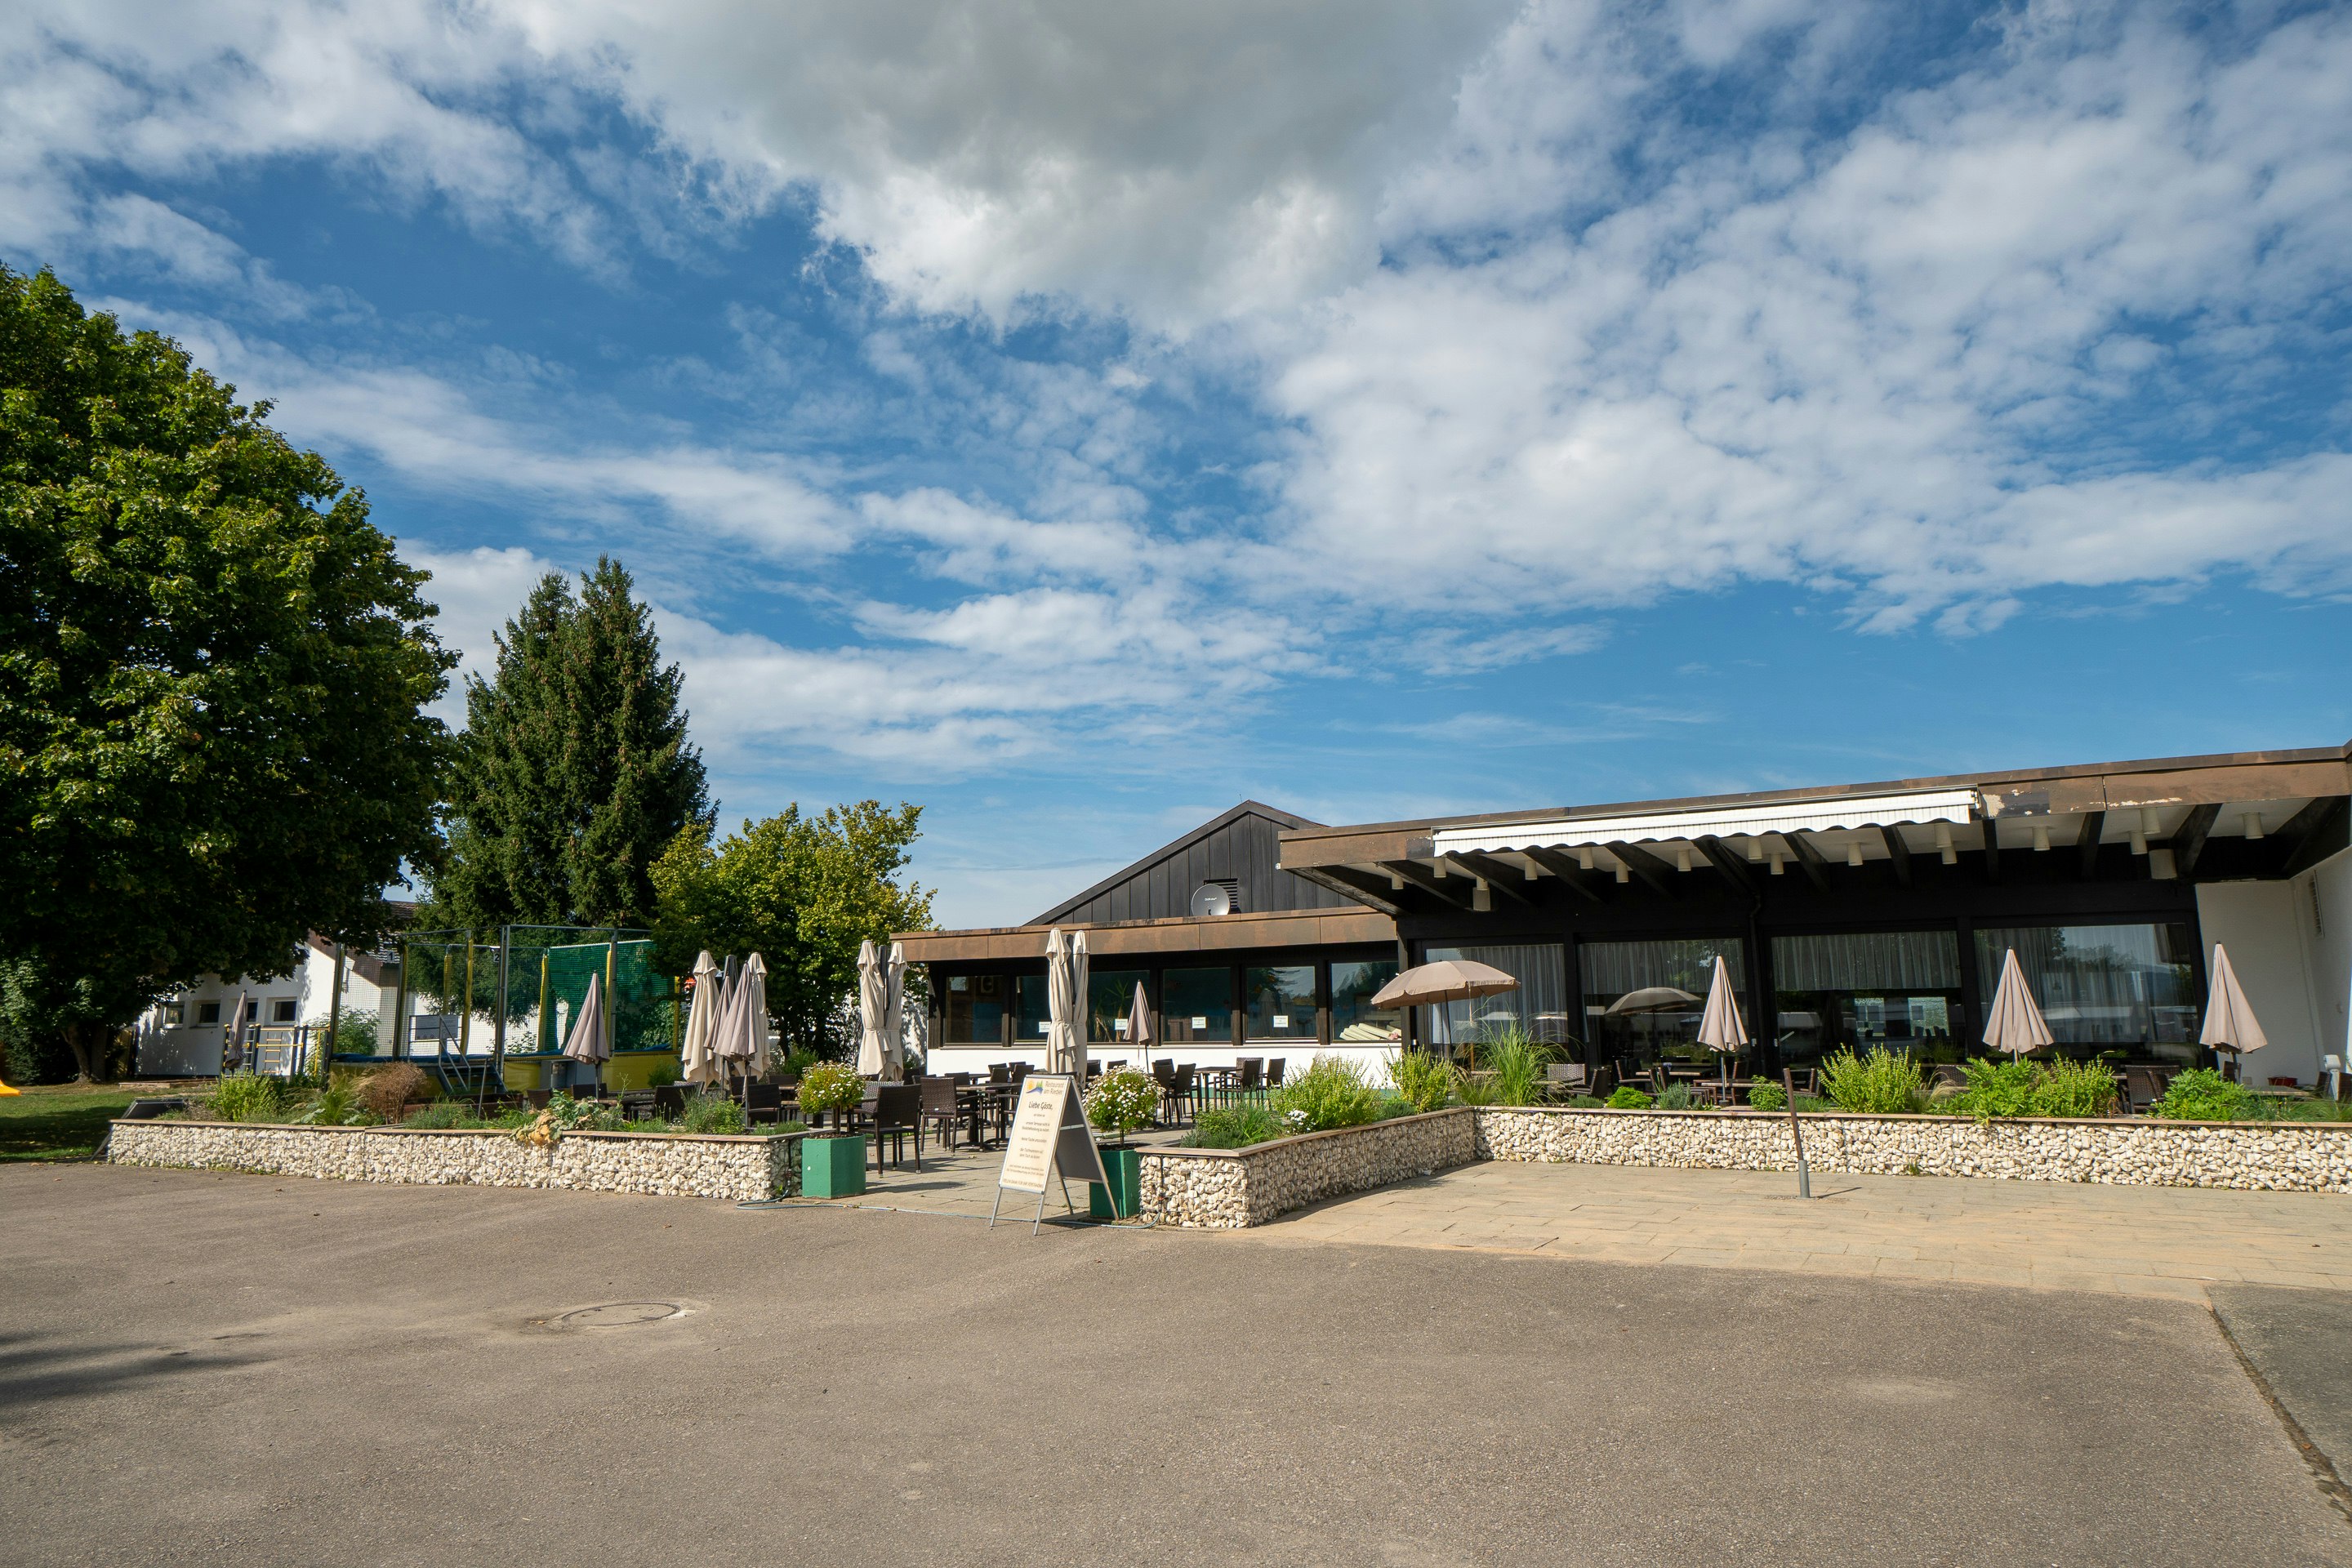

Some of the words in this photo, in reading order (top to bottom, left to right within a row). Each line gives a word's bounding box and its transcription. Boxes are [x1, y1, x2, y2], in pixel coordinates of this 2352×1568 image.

[389, 951, 394, 960] 1
[494, 953, 500, 961] 2
[1028, 1101, 1040, 1109] Liebe
[1040, 1102, 1054, 1111] Gäste,
